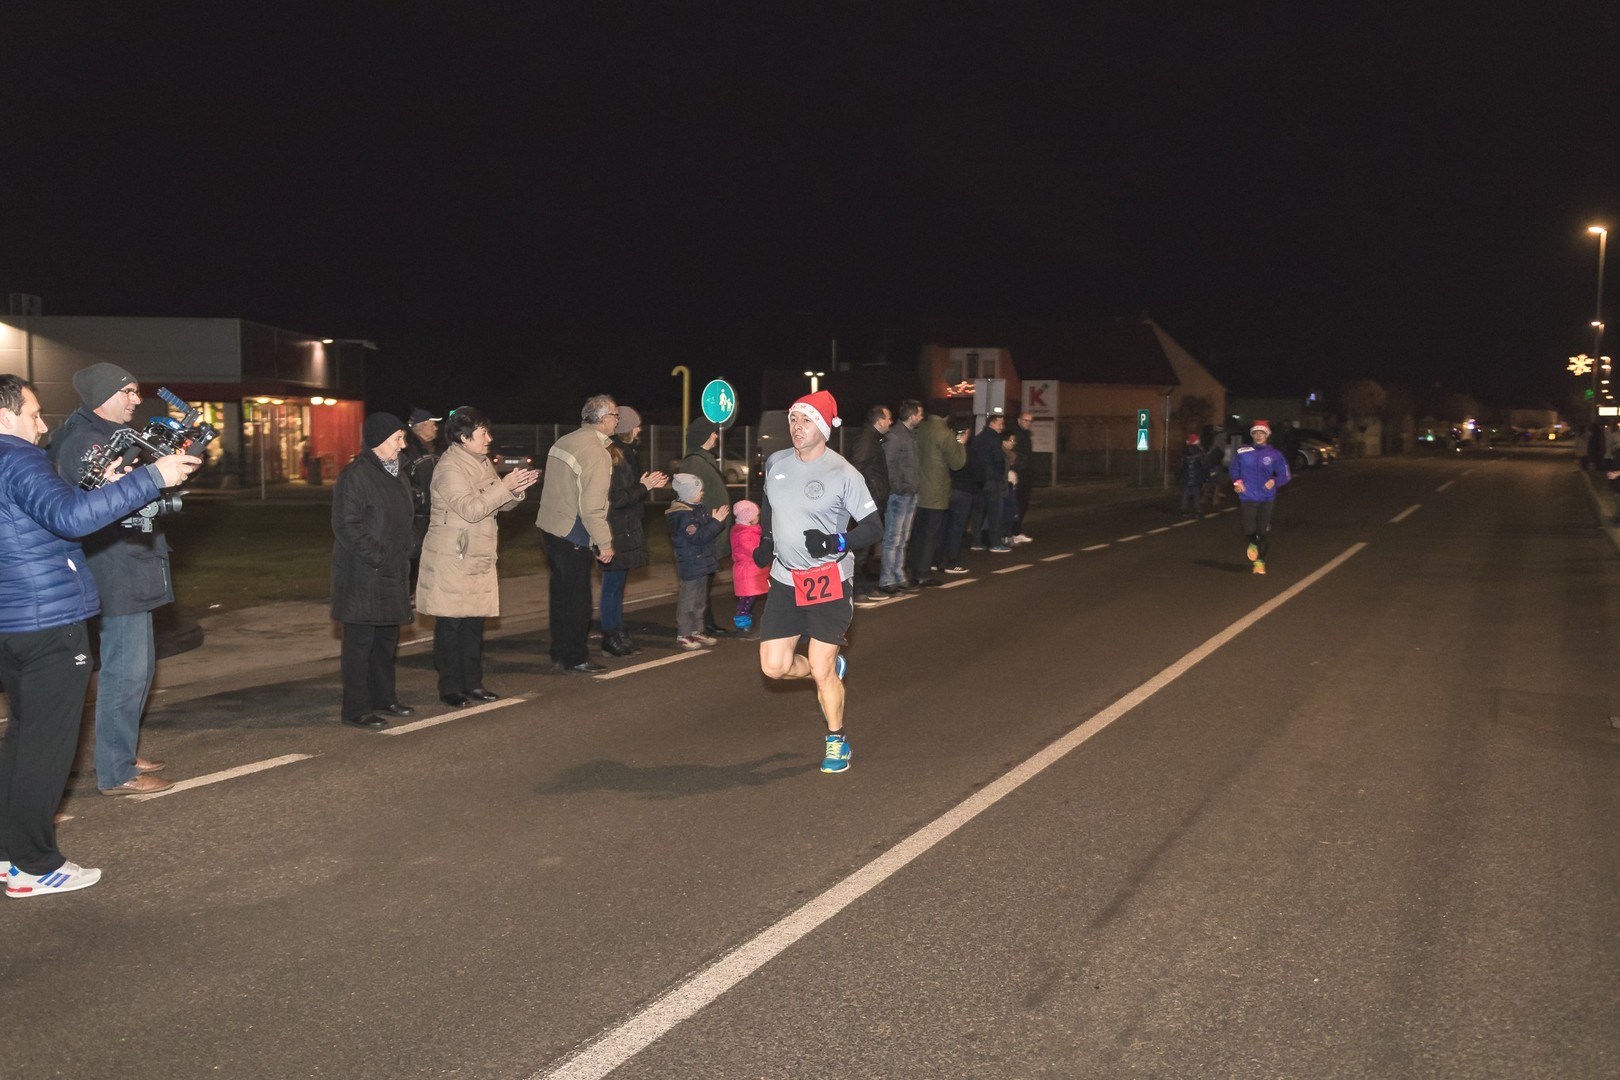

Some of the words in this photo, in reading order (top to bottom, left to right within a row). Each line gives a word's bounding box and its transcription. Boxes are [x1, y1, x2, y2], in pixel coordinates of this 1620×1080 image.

[1030, 387, 1047, 406] K
[1140, 413, 1146, 426] P
[803, 575, 832, 600] 22
